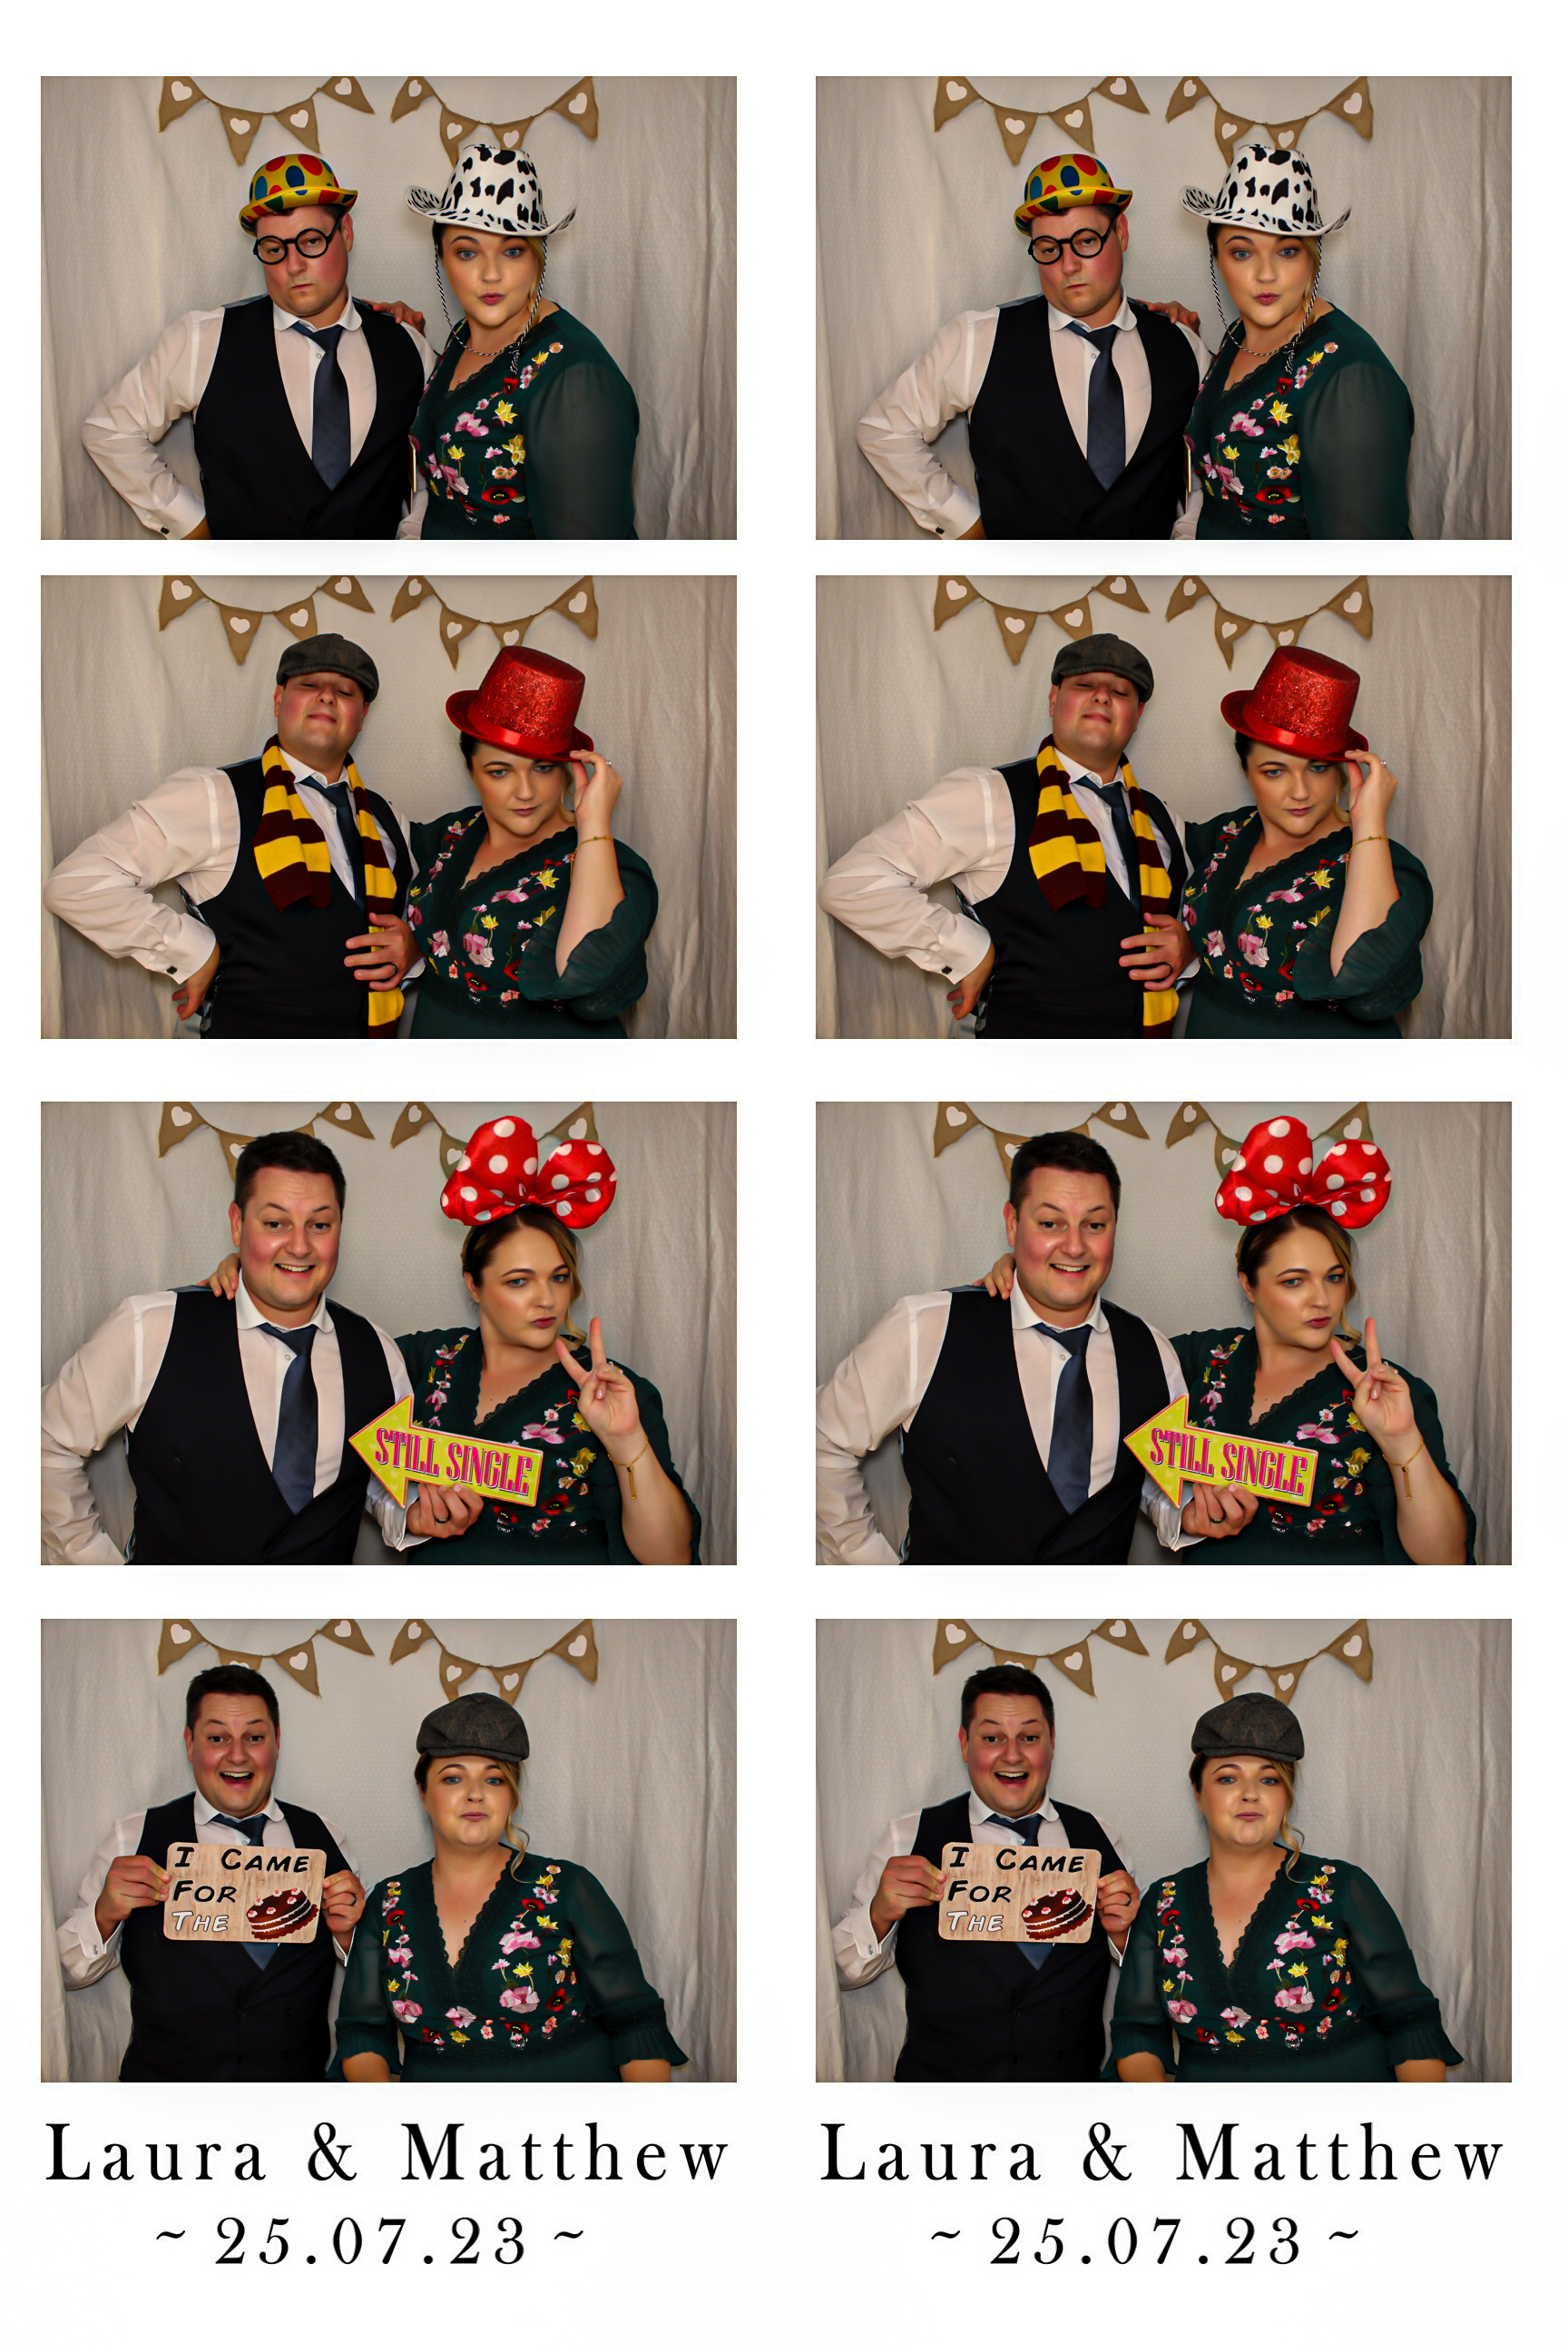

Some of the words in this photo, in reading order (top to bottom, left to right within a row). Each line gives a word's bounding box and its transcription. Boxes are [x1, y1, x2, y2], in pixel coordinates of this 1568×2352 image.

[375, 1427, 439, 1476] STILL
[446, 1443, 533, 1495] SINGLE
[1150, 1427, 1214, 1476] STILL
[1220, 1443, 1308, 1495] SINGLE
[174, 1847, 195, 1867] I
[220, 1848, 309, 1873] CAME
[949, 1847, 970, 1867] I
[995, 1848, 1084, 1873] CAME
[172, 1880, 237, 1903] FOR
[947, 1880, 1012, 1903] FOR
[172, 1910, 230, 1932] THE
[946, 1910, 1004, 1932] THE
